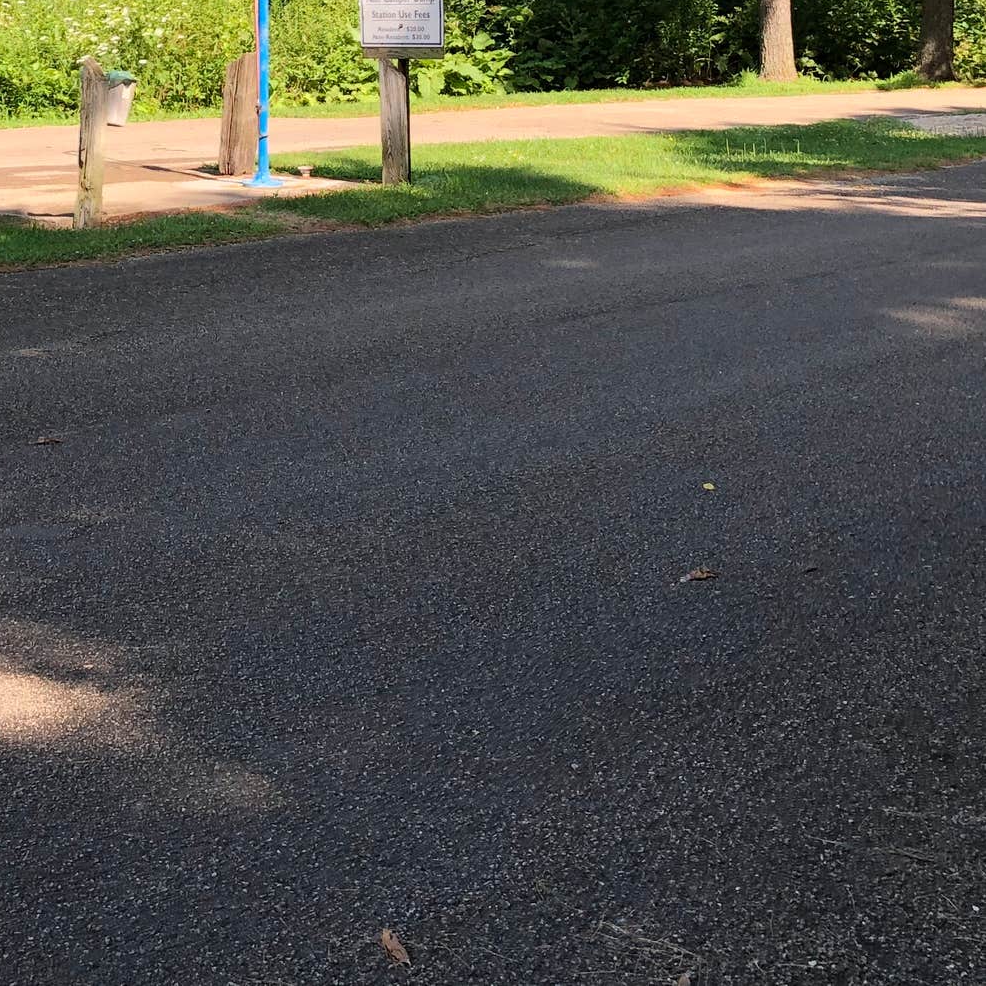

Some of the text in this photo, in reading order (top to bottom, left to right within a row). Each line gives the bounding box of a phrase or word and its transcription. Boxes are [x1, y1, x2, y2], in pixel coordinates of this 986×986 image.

[372, 10, 430, 19] Station Use Fees
